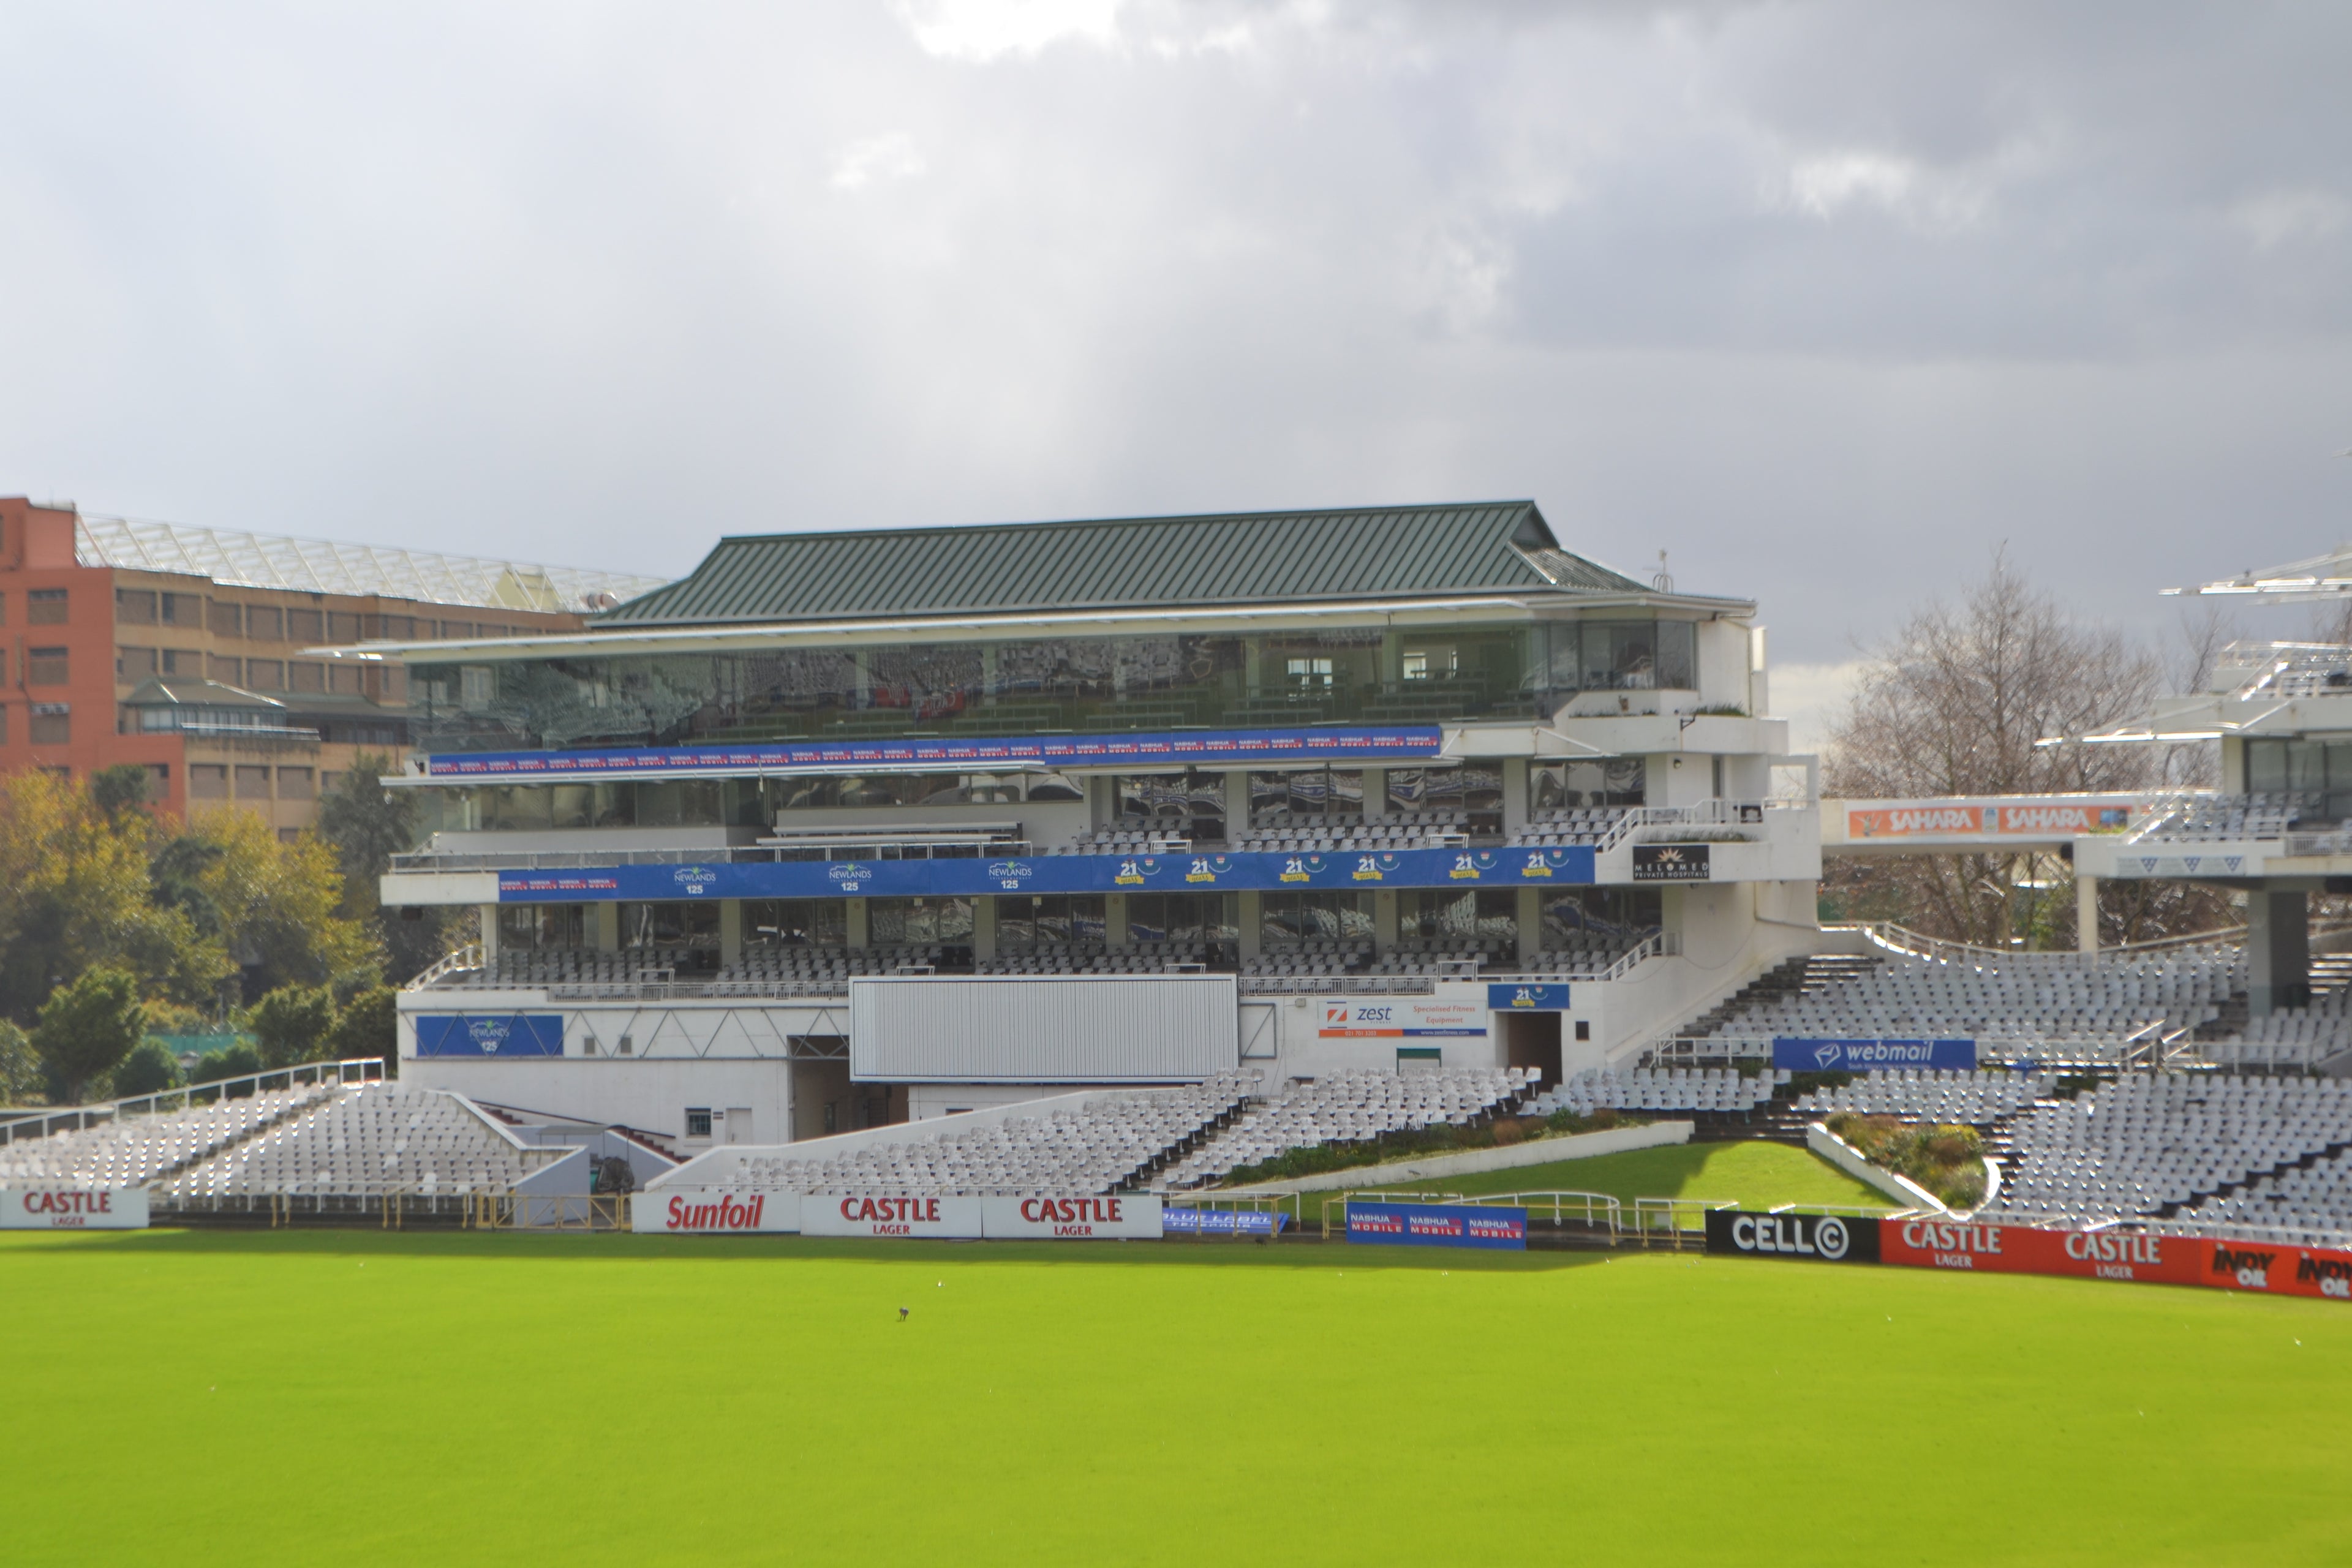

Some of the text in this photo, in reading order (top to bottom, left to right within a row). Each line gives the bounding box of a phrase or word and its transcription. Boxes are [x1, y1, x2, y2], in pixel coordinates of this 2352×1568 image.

[1890, 809, 1973, 831] SAHARA
[2006, 808, 2090, 829] SAHARA
[1191, 861, 1208, 875] 21
[1286, 860, 1302, 873] 21
[1359, 858, 1375, 872] 21
[1455, 856, 1472, 870] 21
[1528, 854, 1545, 869] 21
[1635, 862, 1709, 871] MELOMED
[829, 870, 872, 879] NEWLANDS
[1121, 863, 1137, 876] 21
[674, 873, 715, 882] NEWLANDS
[687, 885, 703, 894] 125
[842, 883, 858, 891] 125
[1001, 880, 1018, 889] 125
[1517, 989, 1529, 1000] 21
[1357, 1007, 1392, 1020] zest
[1847, 1041, 1934, 1061] webmail
[23, 1192, 111, 1213] CASTLE
[840, 1197, 940, 1221] CASTLE
[666, 1195, 764, 1229] Sunfoil
[1020, 1198, 1123, 1223] CASTLE
[51, 1216, 85, 1226] LAGER
[1351, 1214, 1390, 1223] NASHUA
[1410, 1216, 1449, 1225] NASHUA
[1469, 1219, 1509, 1228] NASHUA
[873, 1224, 910, 1235] LAGER
[1054, 1226, 1092, 1236] LAGER
[1352, 1224, 1401, 1232] MOBILE
[1411, 1226, 1461, 1235] MOBILE
[1470, 1229, 1521, 1238] MOBILE
[1733, 1216, 1815, 1253] CELL
[1903, 1224, 2002, 1254] CASTLE
[2065, 1233, 2162, 1264] CASTLE
[1935, 1253, 1972, 1268] LAGER
[2097, 1264, 2133, 1280] LAGER
[2237, 1268, 2267, 1287] OIL
[2320, 1277, 2351, 1297] OIL
